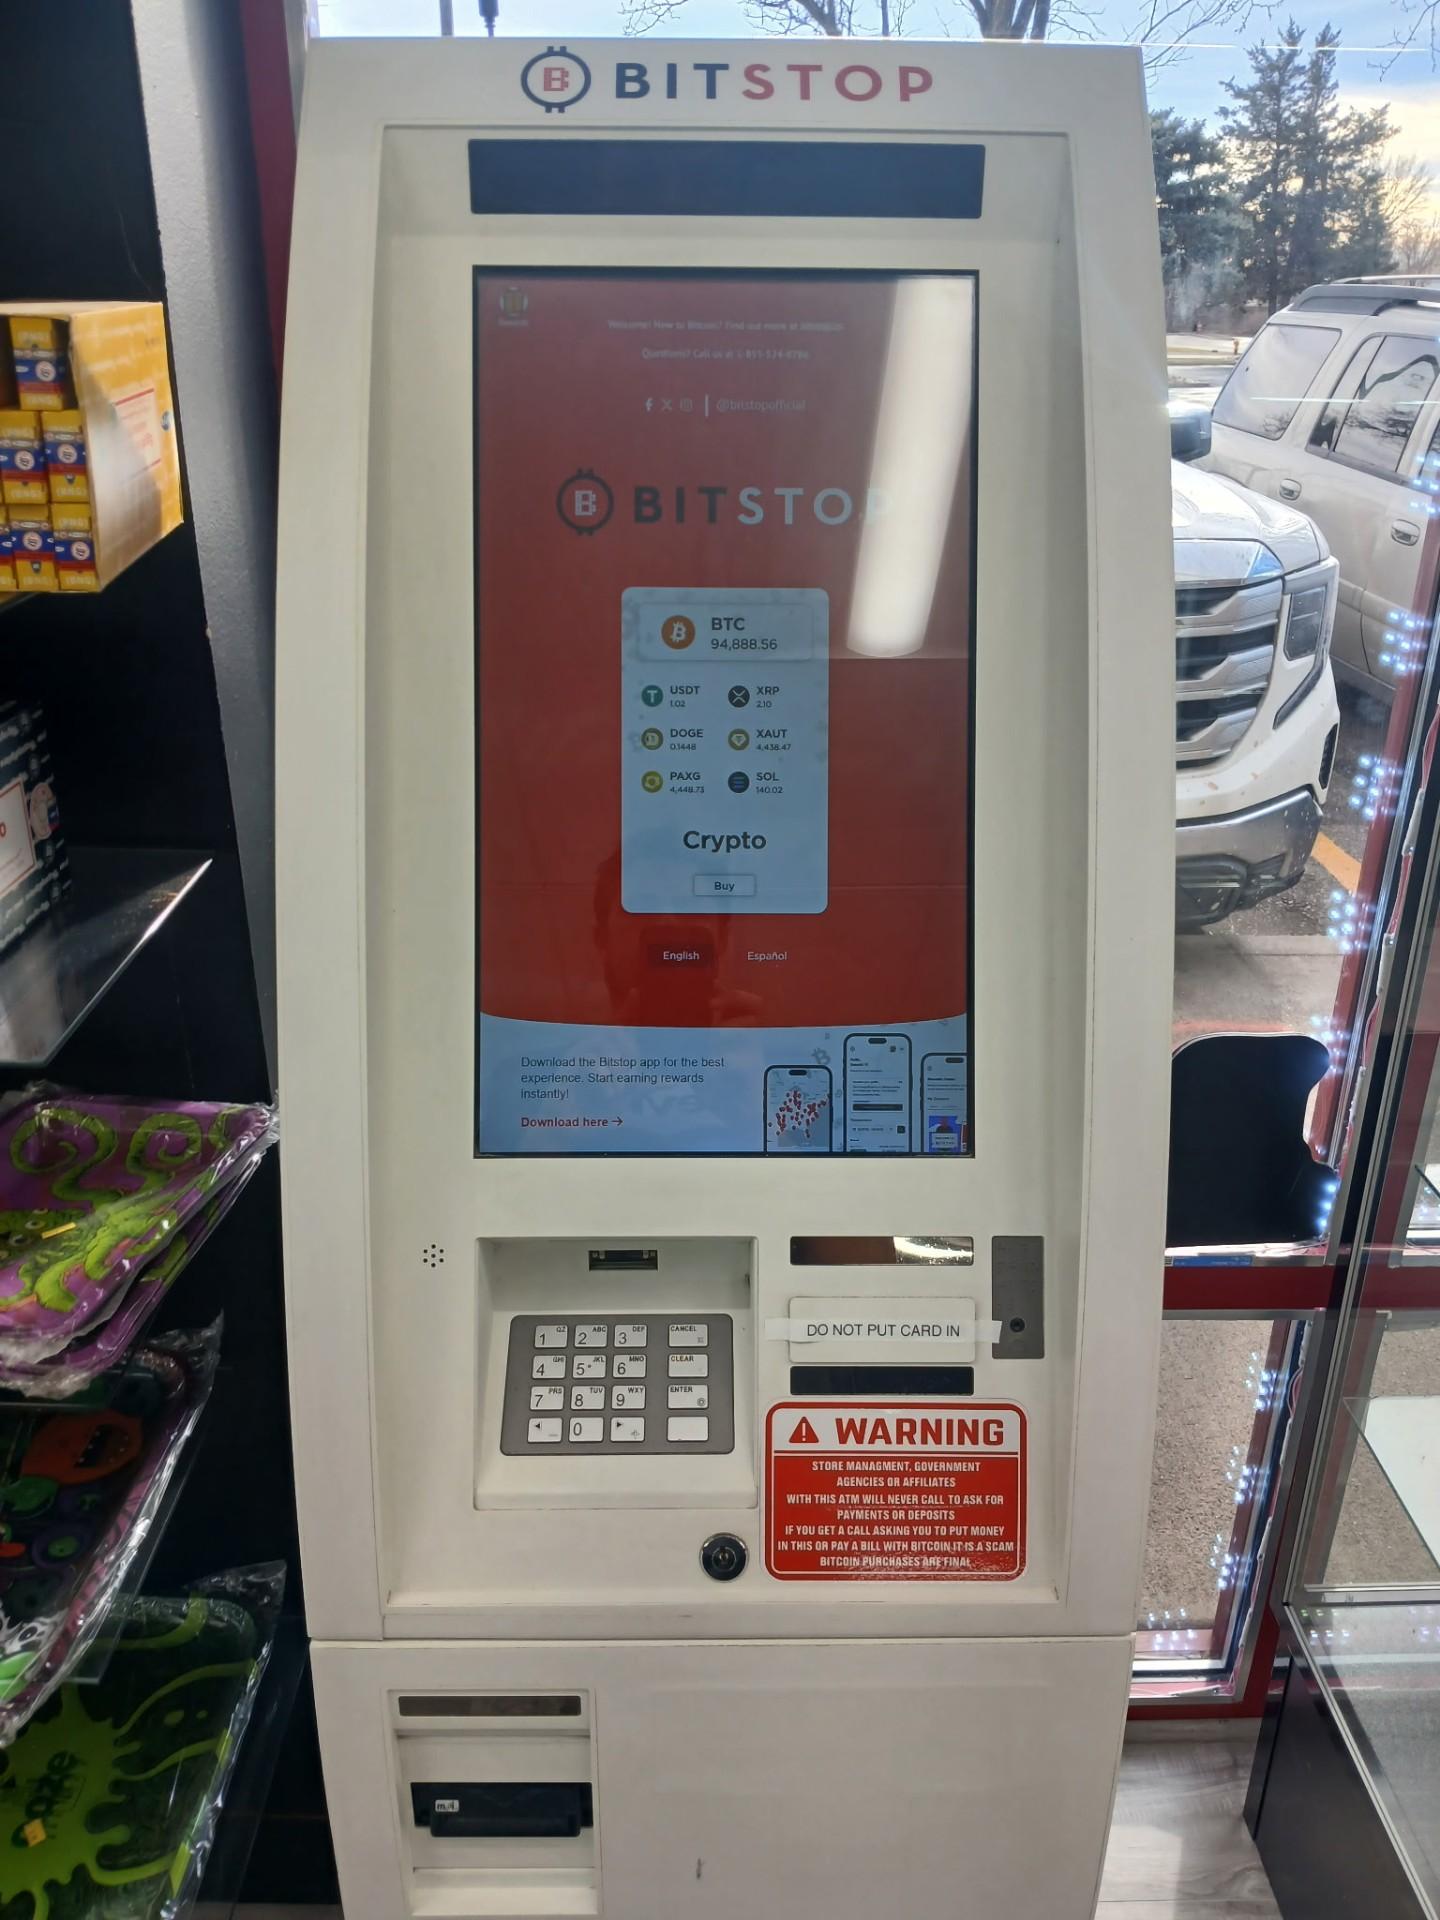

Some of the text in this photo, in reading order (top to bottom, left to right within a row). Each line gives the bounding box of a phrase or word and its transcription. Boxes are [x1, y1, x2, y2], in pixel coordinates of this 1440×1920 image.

[615, 62, 933, 101] BITSTOP
[711, 617, 745, 631] BTC
[711, 638, 778, 651] 94,888.56
[670, 685, 701, 695] USDT
[756, 686, 780, 696] XRP
[670, 728, 704, 738] DOGE
[756, 729, 788, 738] XAUT
[670, 771, 701, 781] PAXG
[756, 772, 779, 782] SOL
[683, 830, 767, 853] Crypto
[714, 881, 735, 892] Buy
[663, 951, 700, 962] English
[747, 951, 788, 962] Español
[521, 1056, 725, 1069] Download the Bitstop app for the best
[521, 1073, 704, 1085] experience. Start earning rewards
[521, 1089, 569, 1101] instantly!
[521, 1117, 609, 1128] Download here
[807, 1324, 960, 1338] DO NOT PUT CARD IN
[538, 1333, 546, 1345] 1
[577, 1332, 587, 1344] 2
[618, 1332, 627, 1344] 3
[536, 1363, 545, 1376] 4
[576, 1363, 585, 1375] 5
[617, 1362, 626, 1375] 6
[534, 1395, 543, 1407] 7
[574, 1394, 583, 1407] 8
[616, 1394, 625, 1406] 9
[573, 1423, 582, 1436] 0
[835, 1418, 1004, 1446] WARNING
[812, 1461, 981, 1473] STORE MANAGMENT, GOVERNMENT
[836, 1477, 956, 1487] AGENCIES OR AFFILIATES
[786, 1494, 1004, 1505] WITH THIS ATM WILL NEVER CALL TO ASK FOR
[837, 1510, 955, 1520] PAYMENTS OR DEPOSITS
[785, 1525, 1005, 1536] IF YOU GET A CALL ASKING YOU TO PUT MONEY
[778, 1541, 788, 1551] IN
[790, 1541, 812, 1551] THIS
[815, 1541, 829, 1551] OR
[831, 1541, 849, 1551] PAY
[851, 1541, 859, 1551] A
[861, 1541, 880, 1551] BILL
[883, 1541, 908, 1551] WITH
[964, 1541, 974, 1551] IS
[976, 1541, 983, 1551] A
[985, 1541, 1014, 1551] SCAM
[820, 1556, 971, 1567] BITCOIN PURCHASES ARE FINAL
